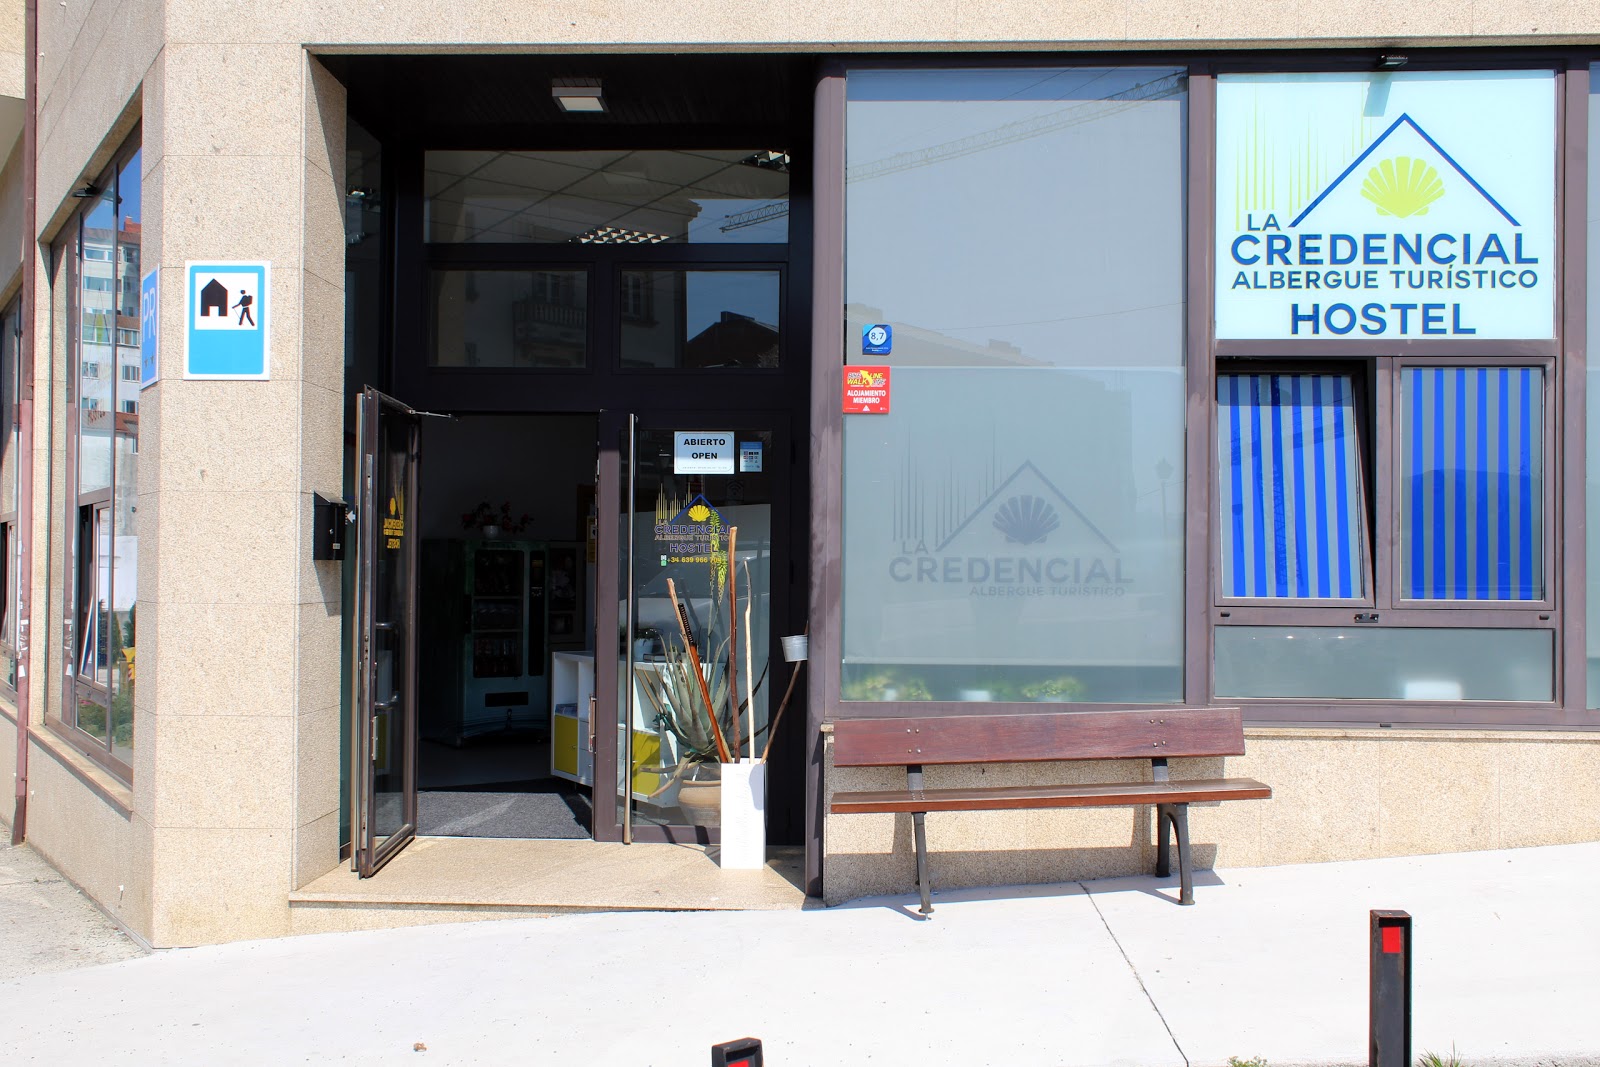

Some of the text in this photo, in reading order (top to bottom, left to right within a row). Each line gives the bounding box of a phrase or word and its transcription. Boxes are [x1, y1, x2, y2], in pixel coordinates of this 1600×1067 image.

[1247, 213, 1281, 231] LA
[1230, 233, 1539, 266] CREDENCIAL
[1231, 264, 1538, 289] ALBERGUE TURÍSTICO
[142, 287, 156, 342] PR
[1291, 303, 1476, 335] HOSTEL
[870, 332, 885, 341] 8,7
[902, 540, 929, 555] LA
[889, 557, 1135, 583] CREDENCIAL
[969, 586, 1044, 597] ALBERGUE
